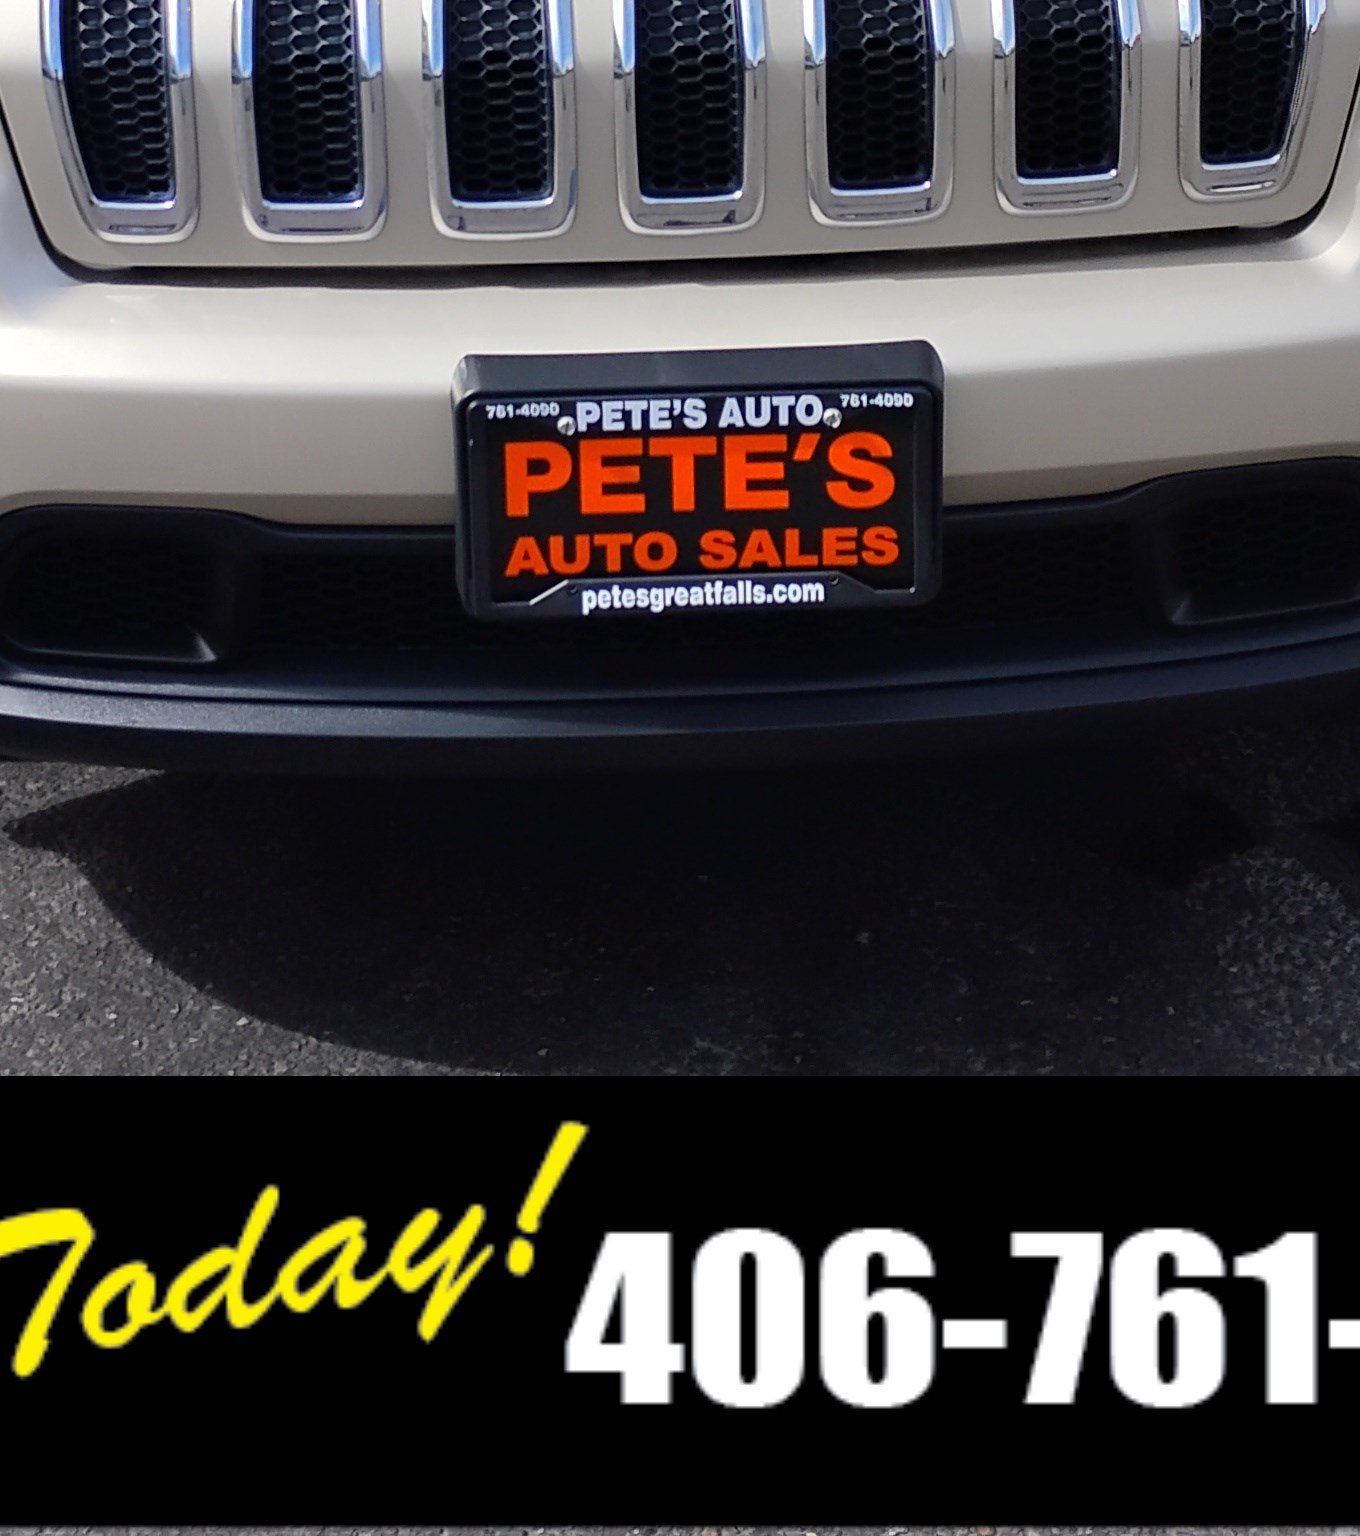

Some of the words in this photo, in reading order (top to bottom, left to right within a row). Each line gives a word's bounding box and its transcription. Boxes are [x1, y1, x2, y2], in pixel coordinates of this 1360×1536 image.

[485, 402, 560, 420] 761-4090
[576, 398, 707, 432] PETE'S
[718, 394, 824, 428] AUTO
[840, 392, 914, 408] 761-4090
[504, 431, 896, 518] PETE'S
[505, 531, 678, 577] AUTO
[699, 525, 899, 569] SALES
[582, 580, 825, 615] petesgreatfalls.com
